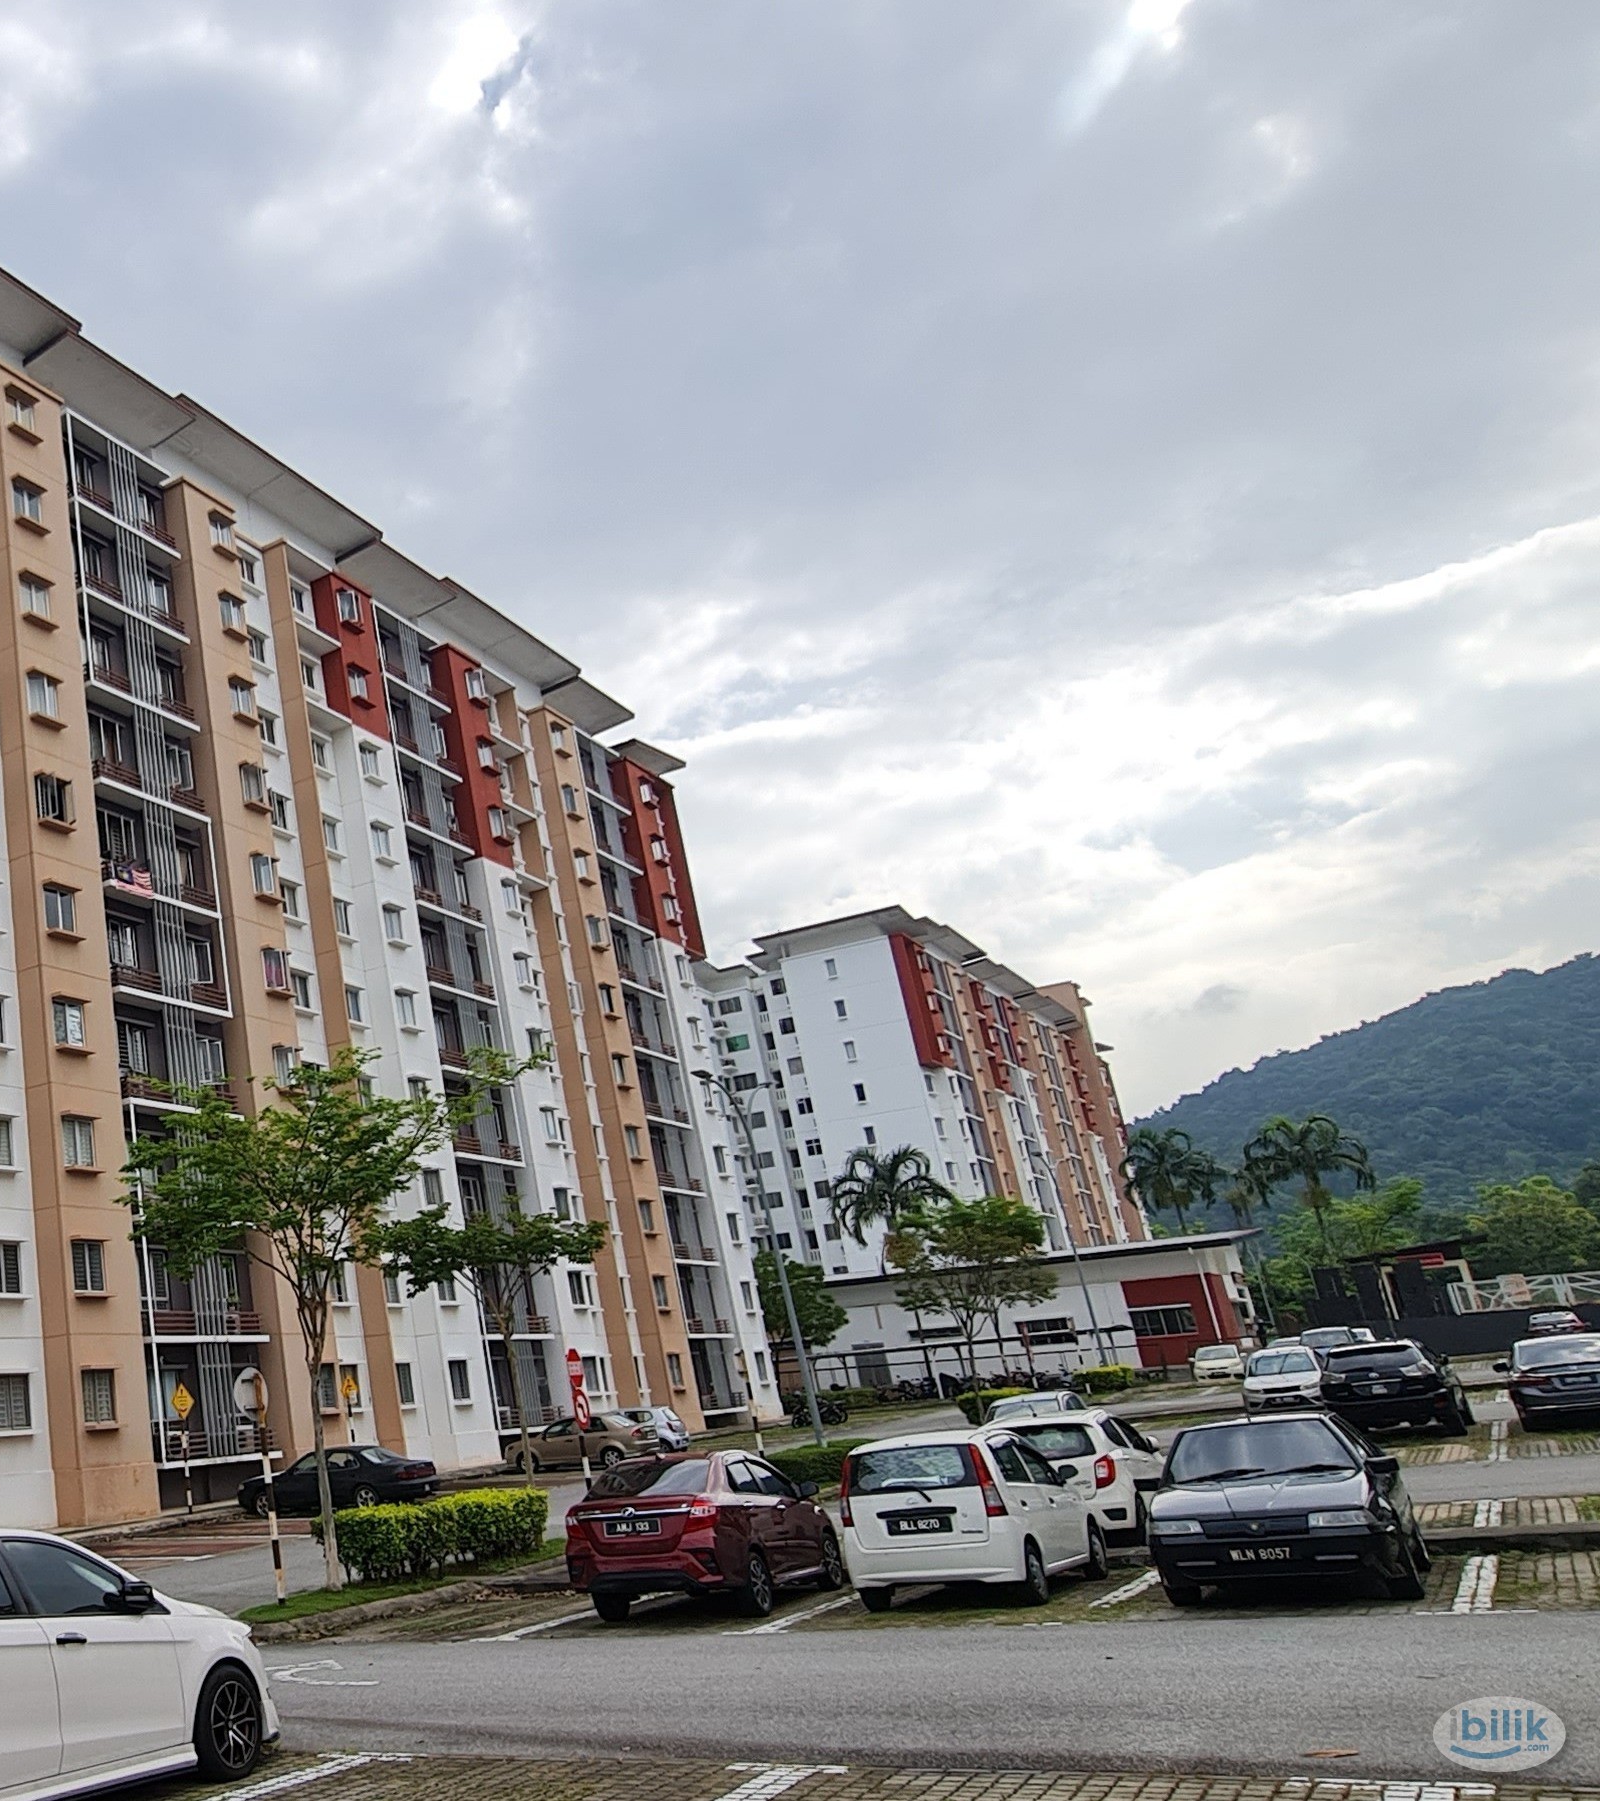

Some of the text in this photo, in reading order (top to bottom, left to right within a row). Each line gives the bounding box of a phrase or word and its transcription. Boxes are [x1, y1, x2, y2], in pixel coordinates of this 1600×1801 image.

[900, 1519, 940, 1530] BLL 8270
[1229, 1547, 1290, 1561] WLN 8057
